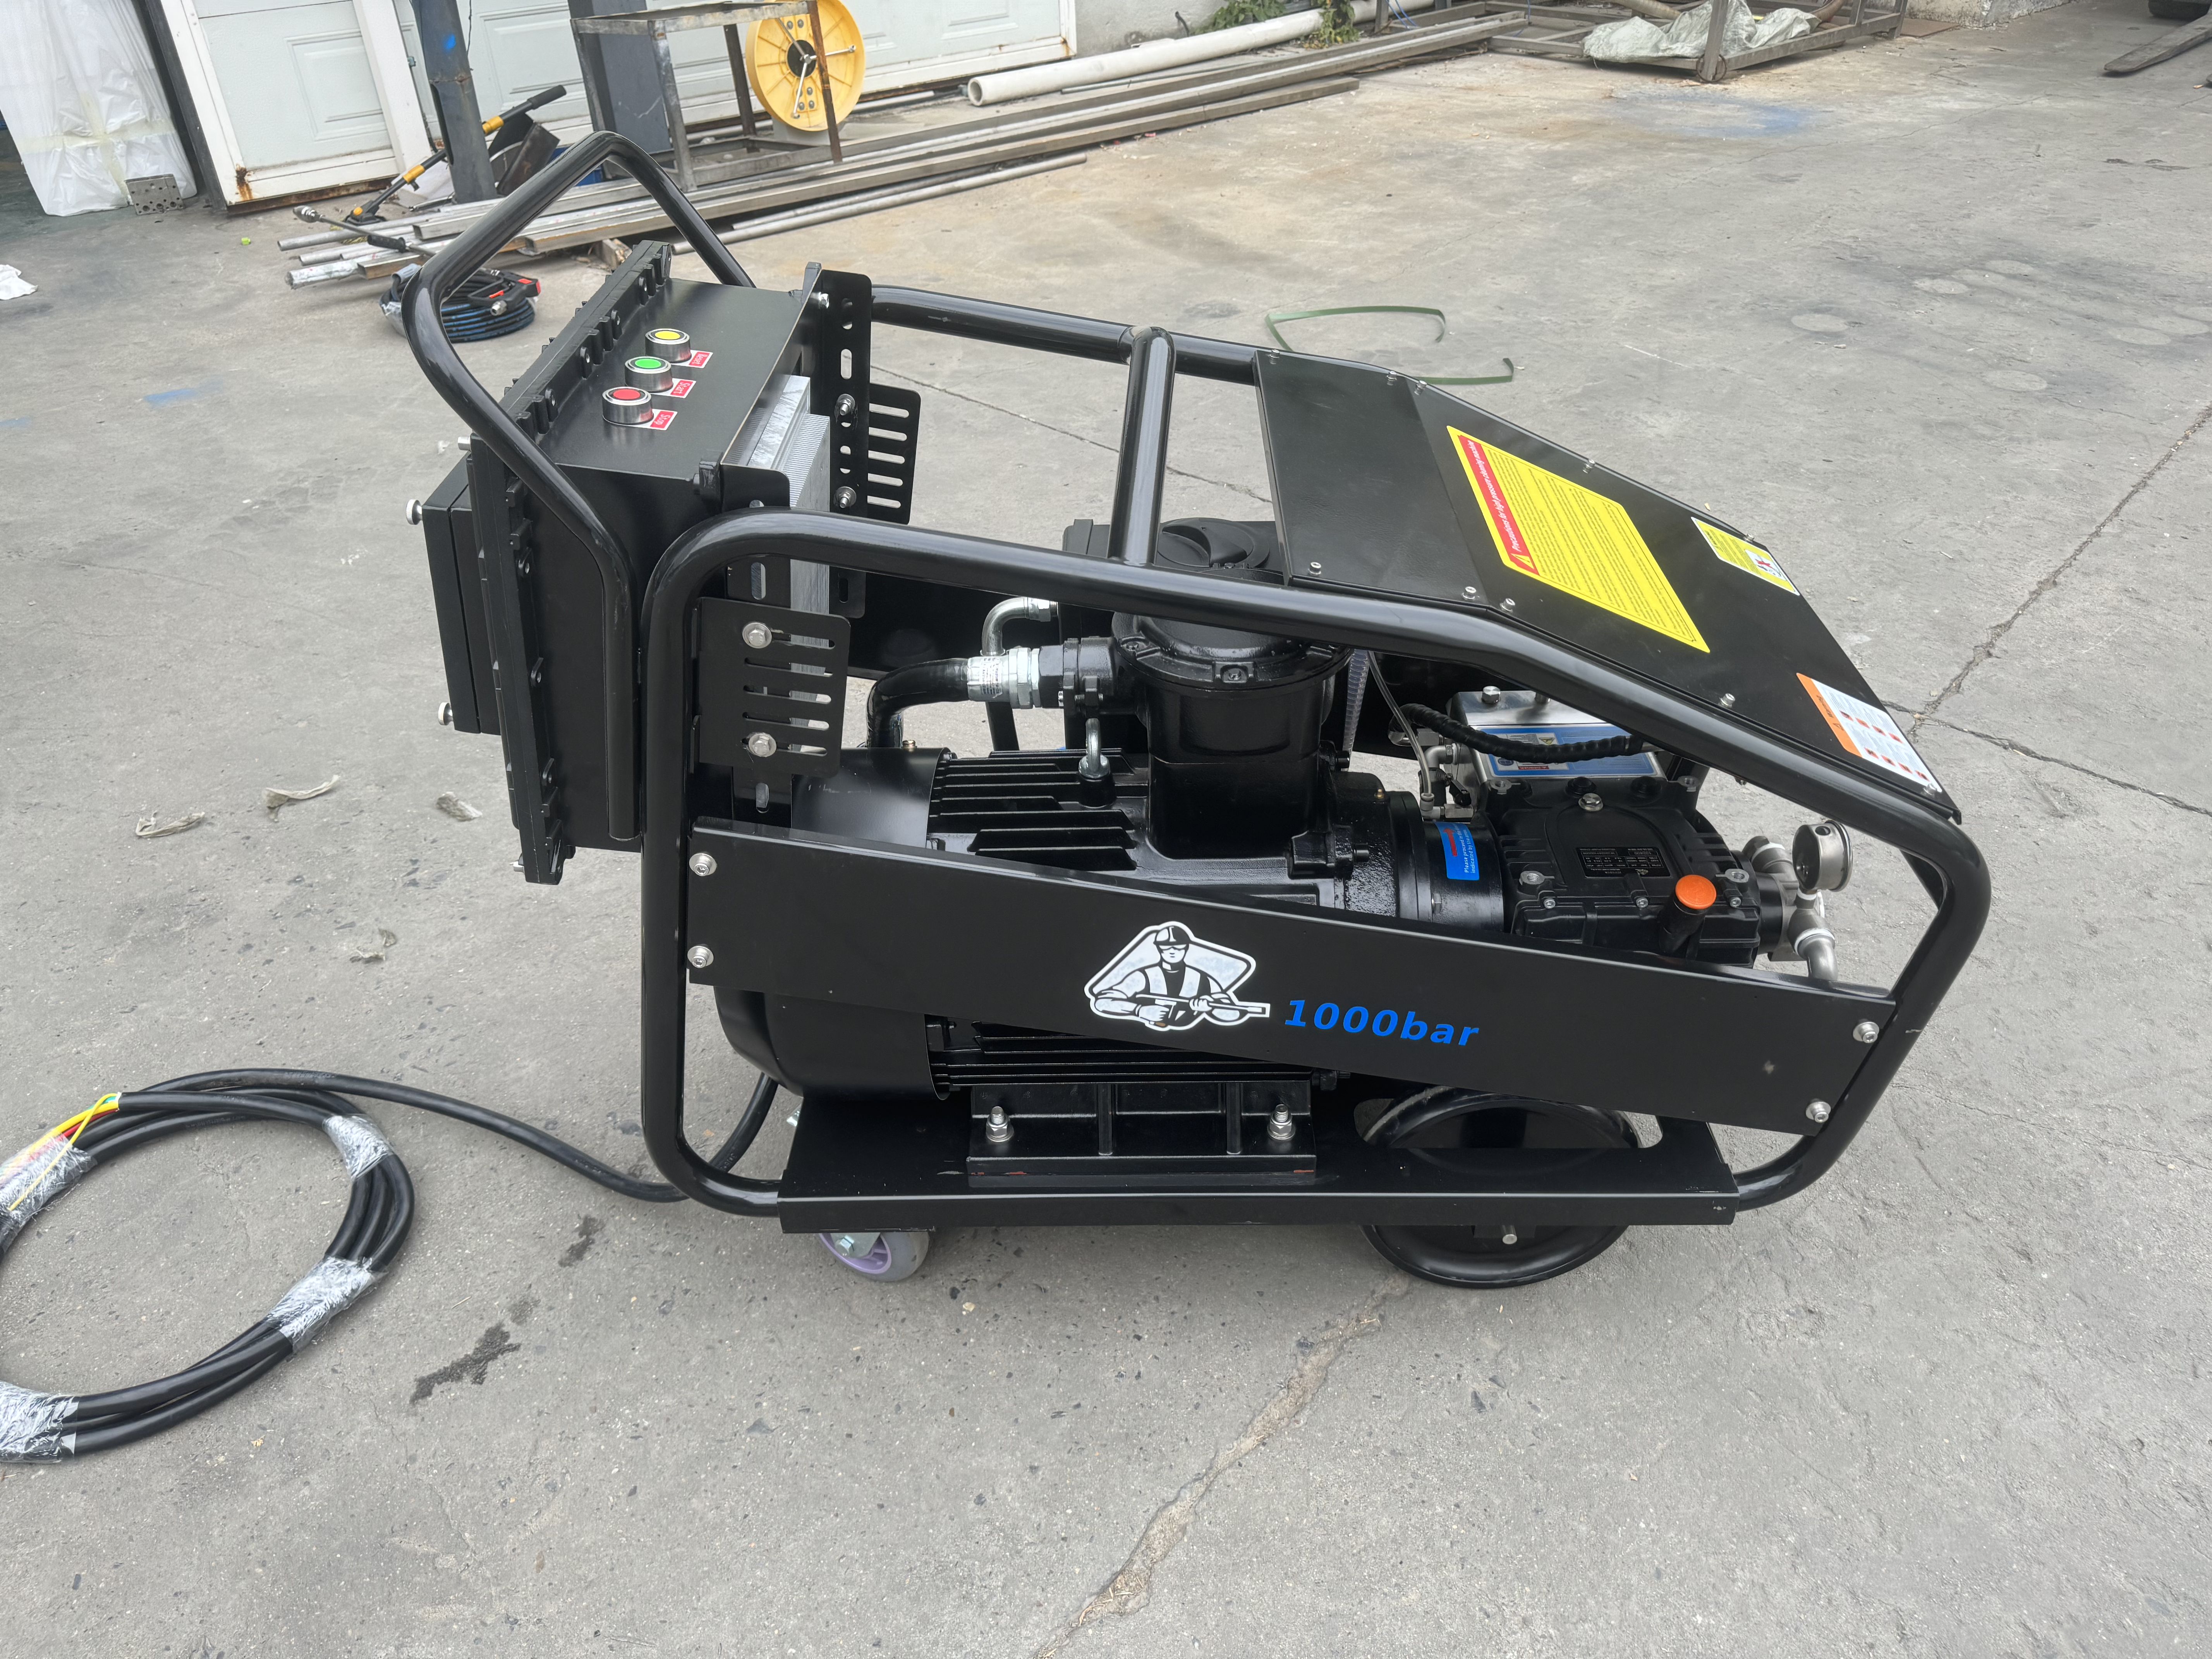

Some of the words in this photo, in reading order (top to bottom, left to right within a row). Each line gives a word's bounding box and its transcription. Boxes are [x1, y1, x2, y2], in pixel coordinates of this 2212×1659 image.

[692, 353, 708, 365] Reset
[673, 382, 691, 394] Start
[654, 414, 671, 425] Stop
[1468, 440, 1480, 460] machine
[1476, 459, 1489, 479] cleaning
[1484, 477, 1501, 502] pressure
[1492, 500, 1504, 512] high
[1498, 510, 1507, 520] for
[1502, 519, 1522, 552] Precautions
[1459, 840, 1469, 856] proceed
[1285, 1000, 1479, 1046] 1000bar
